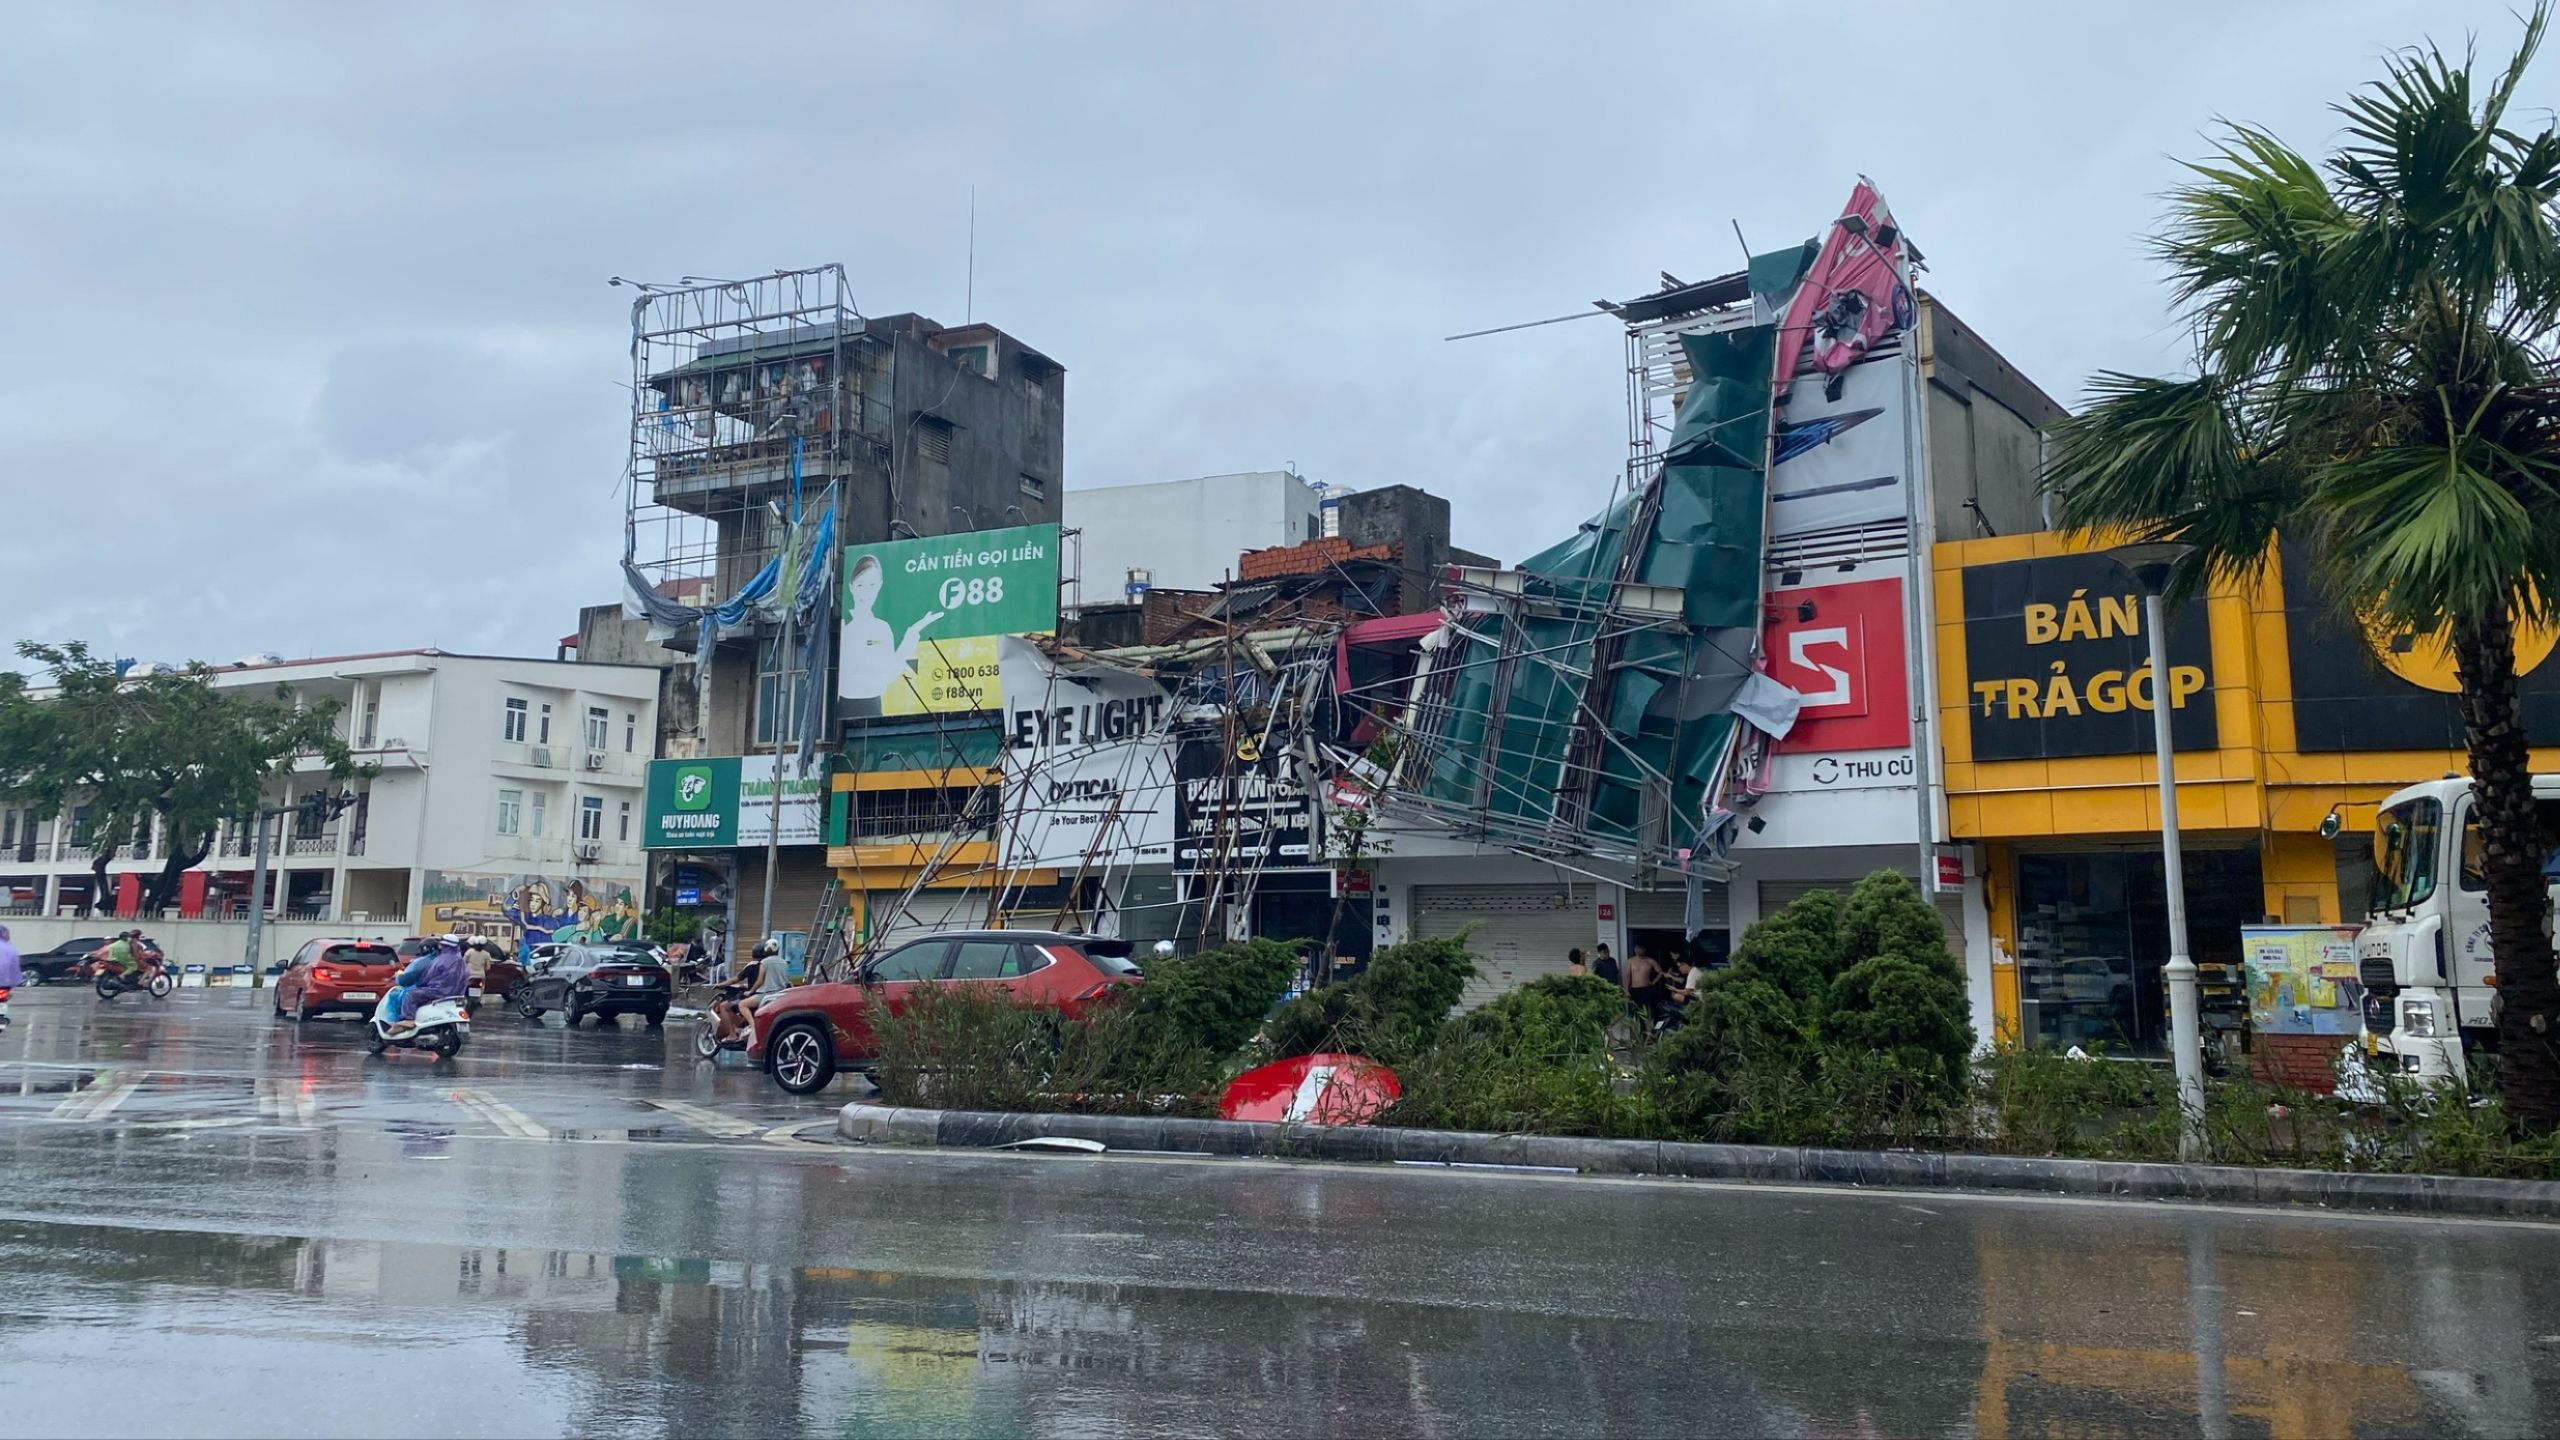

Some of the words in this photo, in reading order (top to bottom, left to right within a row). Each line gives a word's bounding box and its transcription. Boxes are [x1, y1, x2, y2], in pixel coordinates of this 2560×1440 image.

[905, 552, 938, 573] CẦN
[943, 548, 972, 569] TIỀN
[977, 550, 1007, 568] GỌI
[1011, 541, 1043, 562] LIỀN
[939, 577, 1003, 609] F88
[2024, 588, 2139, 645] BÁN
[978, 665, 1000, 677] 638
[946, 687, 983, 699] f88.vn
[1973, 661, 2082, 719] TRẢ
[2085, 656, 2206, 713] GÓP
[1015, 706, 1074, 749] EYE
[1079, 695, 1163, 744] LIGHT
[1845, 762, 1882, 778] THU
[1888, 755, 1913, 777] CŨ
[1049, 779, 1120, 803] OPTICAL
[661, 814, 720, 829] HUYHOANG
[1062, 815, 1078, 825] Your
[1080, 814, 1097, 824] Best
